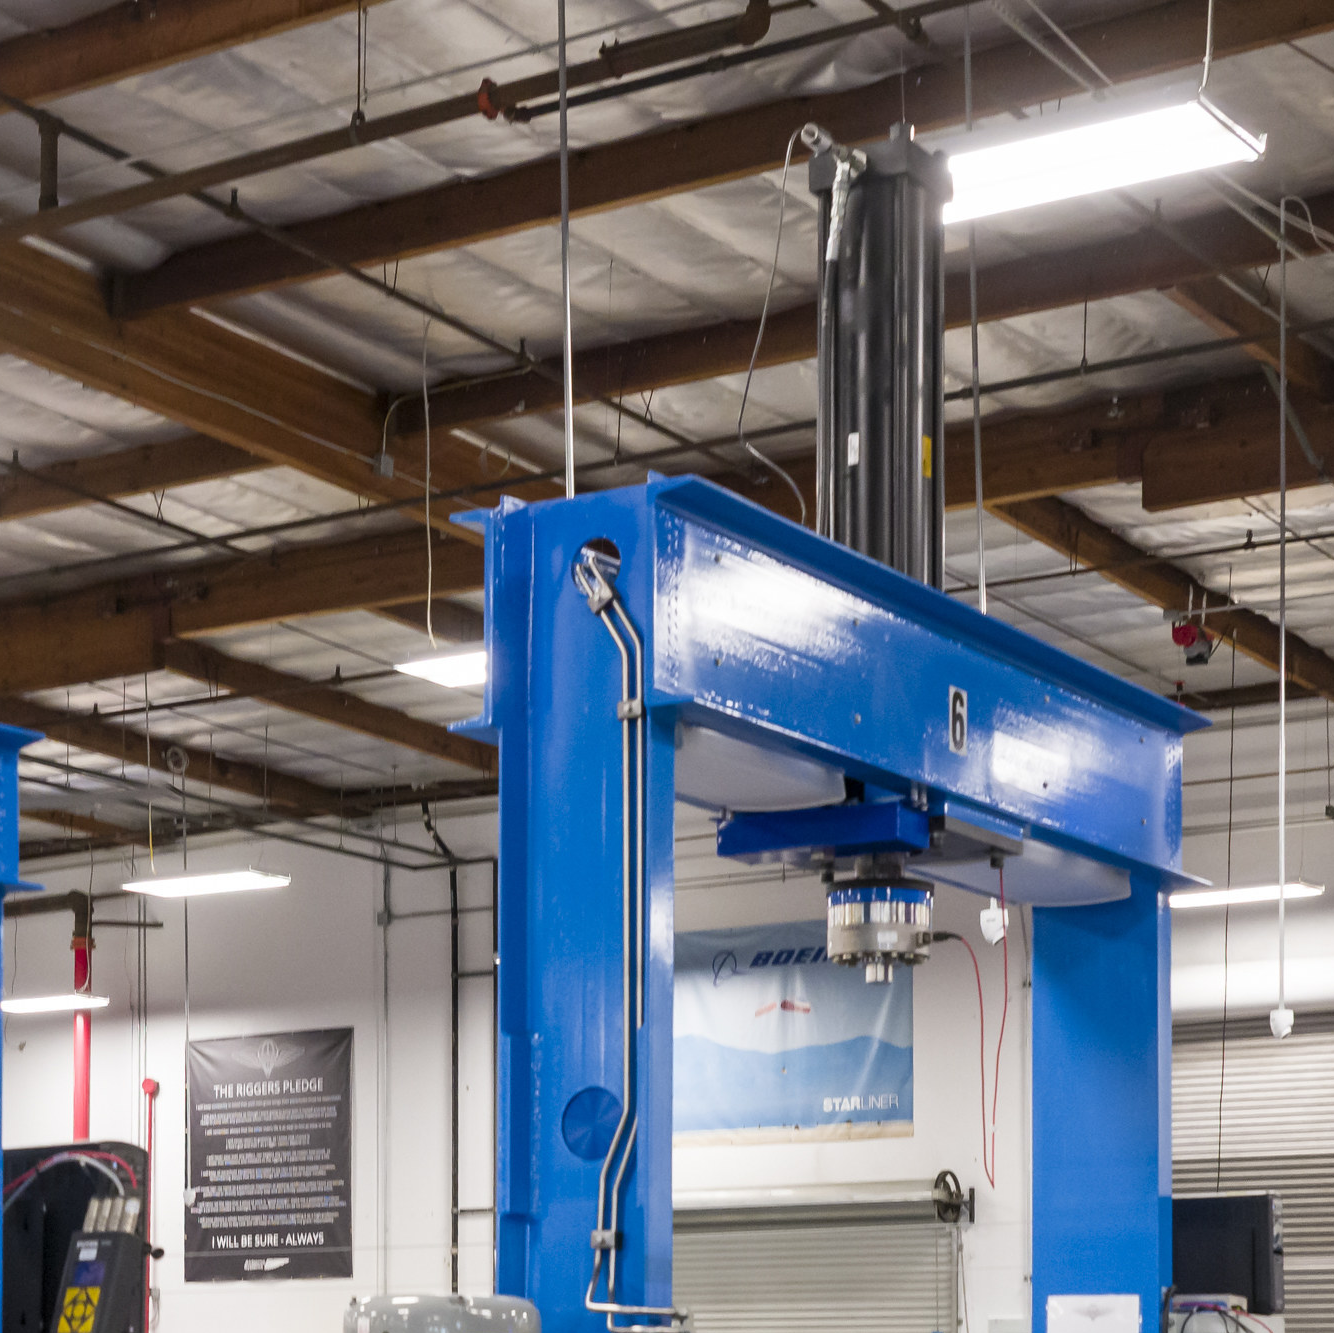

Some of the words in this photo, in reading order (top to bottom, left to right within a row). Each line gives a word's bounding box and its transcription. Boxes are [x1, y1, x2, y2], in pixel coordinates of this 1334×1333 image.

[952, 691, 965, 751] 6
[749, 946, 827, 968] BOEI
[213, 1083, 234, 1099] THE
[236, 1080, 281, 1098] RIGGERS
[283, 1077, 324, 1095] PLEDGE
[823, 1093, 899, 1113] STARLINER
[217, 1234, 239, 1249] WILL
[241, 1233, 253, 1248] BE
[255, 1232, 279, 1248] SURE
[285, 1231, 324, 1247] ALWAYS
